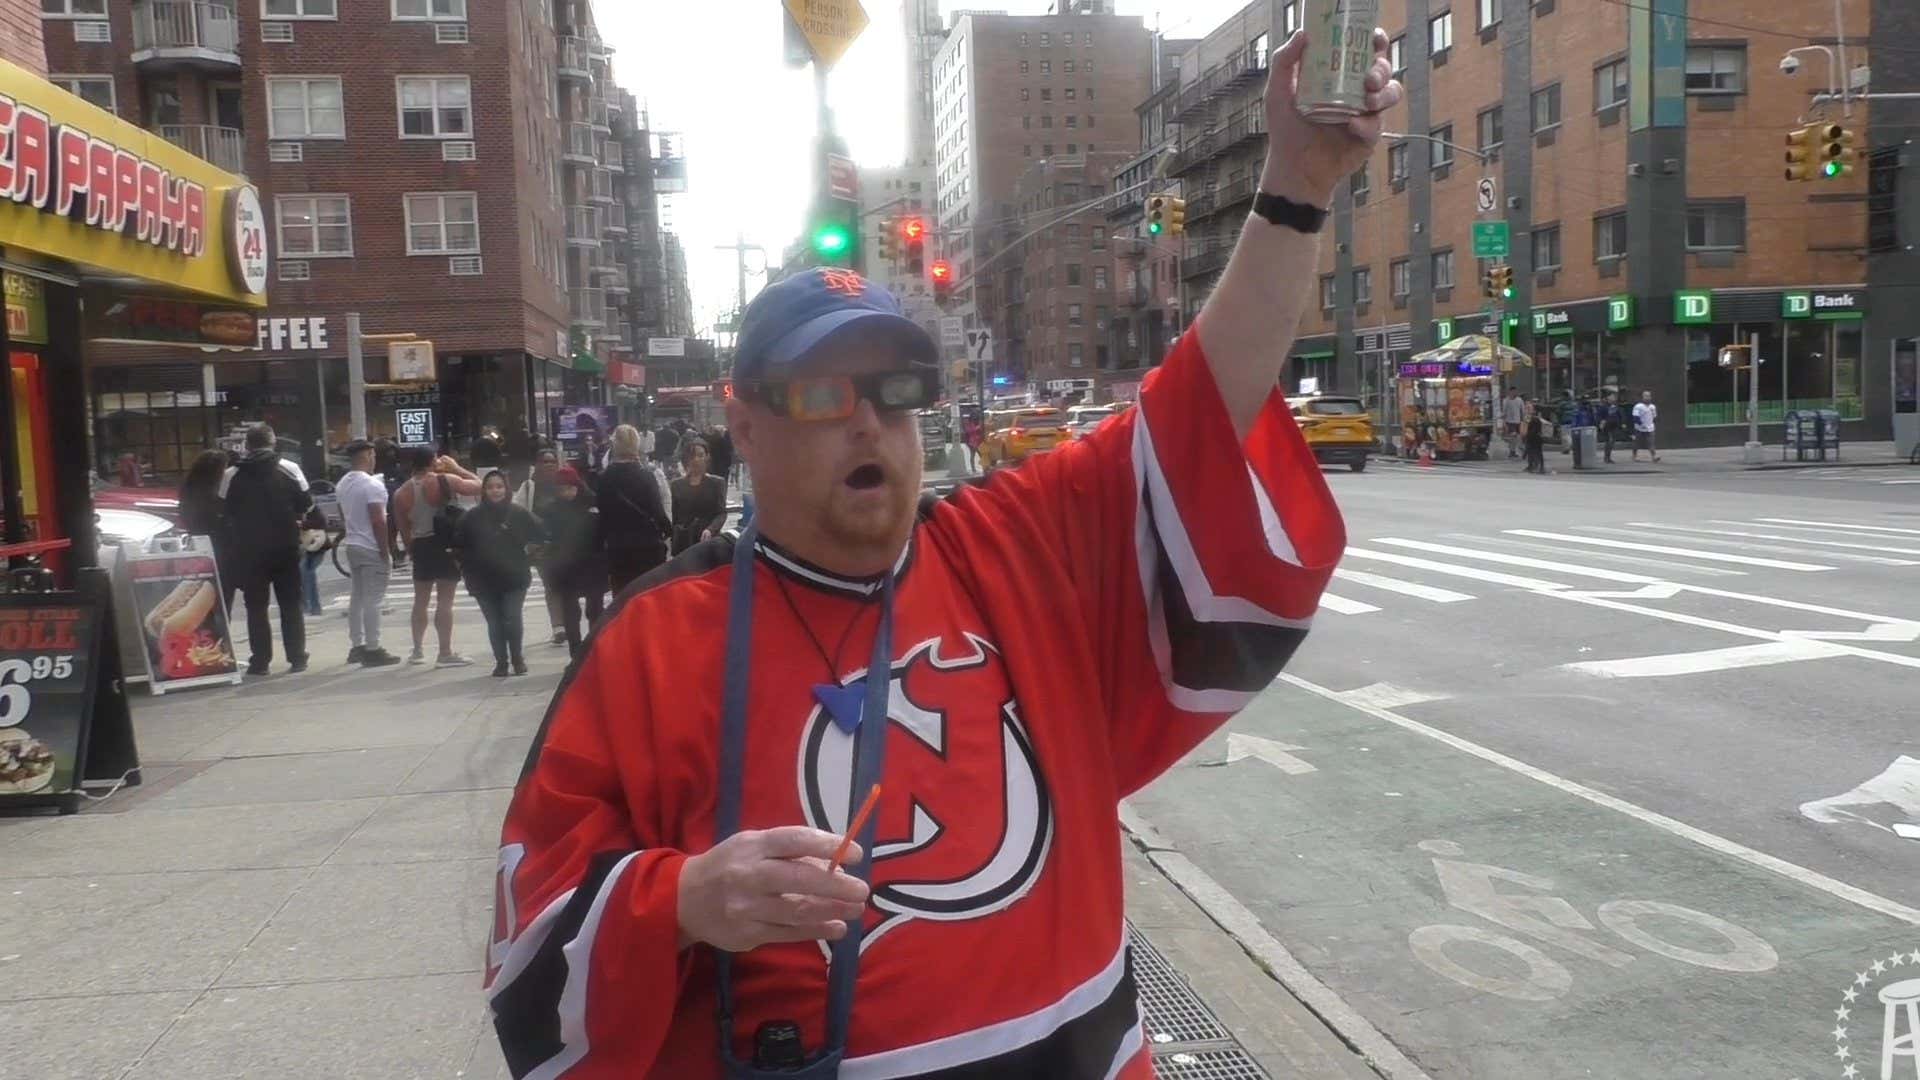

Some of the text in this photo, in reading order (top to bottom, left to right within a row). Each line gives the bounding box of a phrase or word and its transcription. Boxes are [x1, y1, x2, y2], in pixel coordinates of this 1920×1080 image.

[56, 124, 207, 257] PAPAYA
[242, 226, 262, 260] 24
[1611, 302, 1628, 322] TD
[1680, 295, 1709, 317] TD
[1785, 294, 1854, 312] TD Bank
[1533, 311, 1568, 329] TD Bank
[1438, 321, 1451, 340] TD
[400, 411, 428, 425] EAST
[402, 423, 425, 435] ONE
